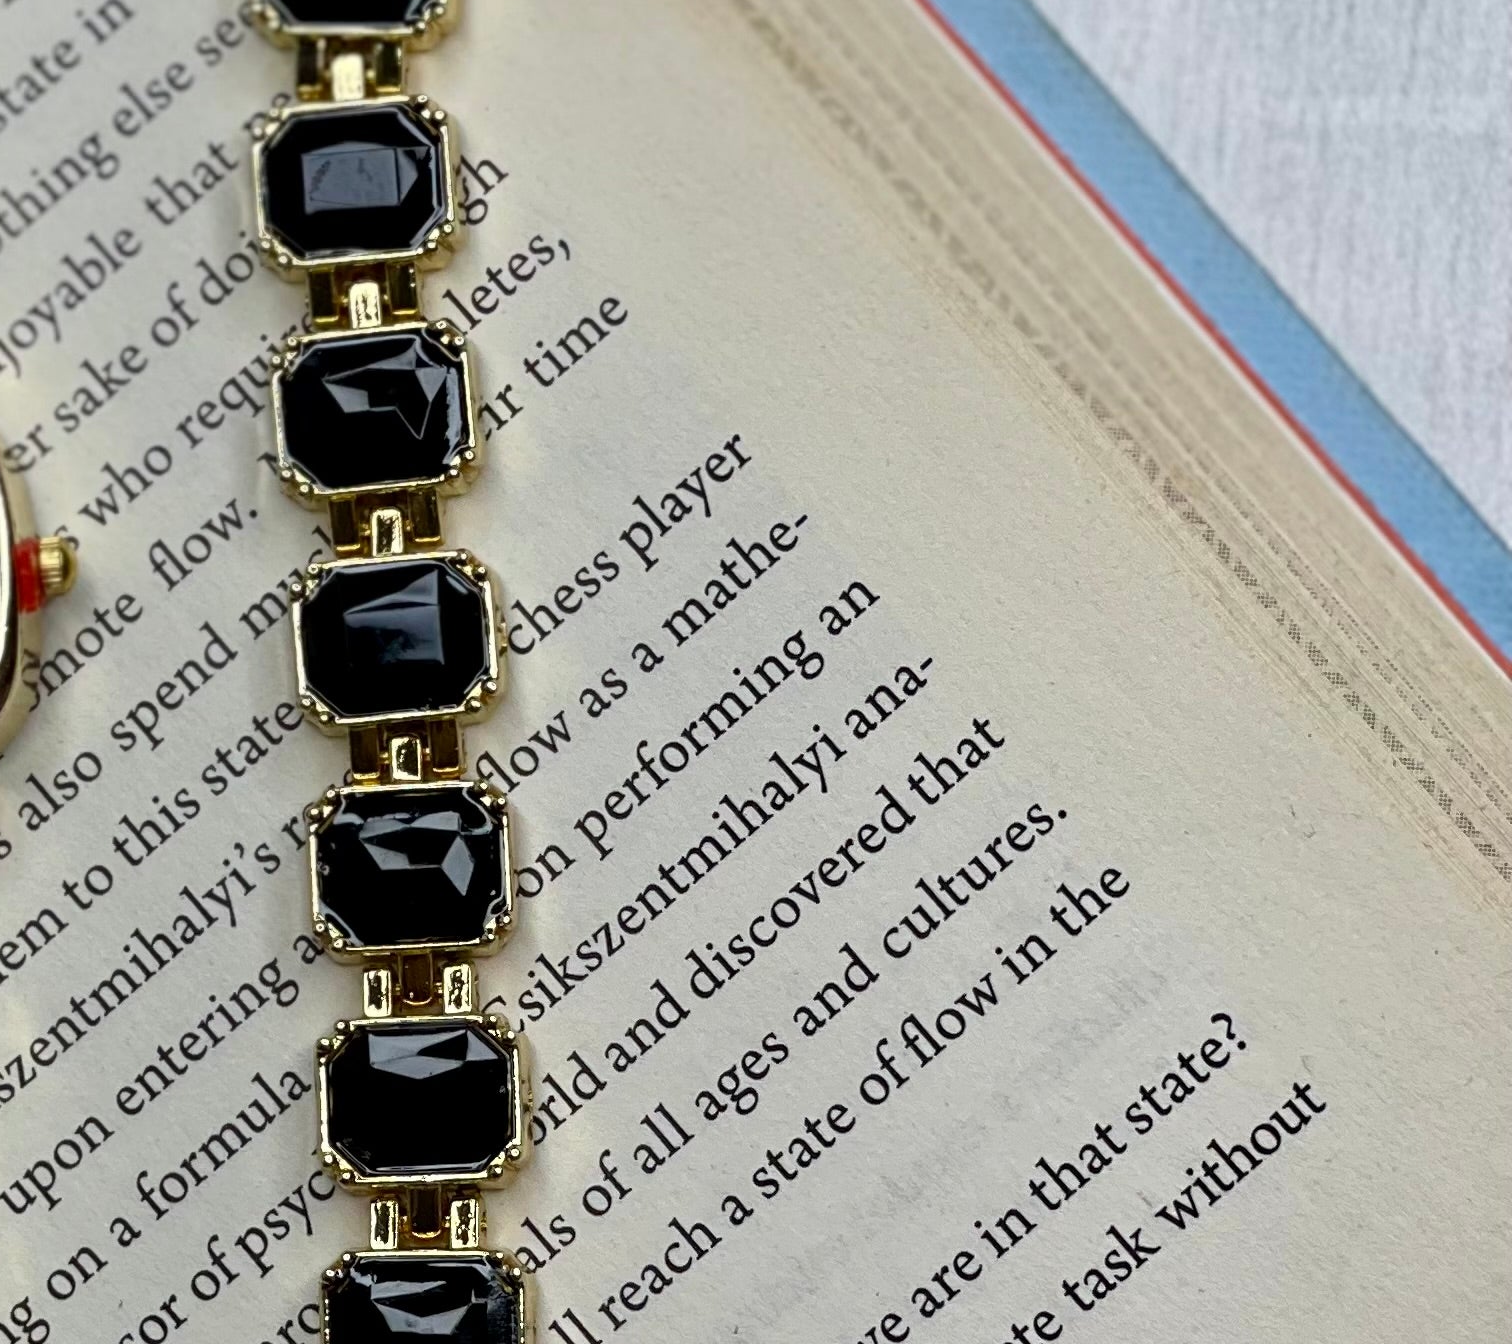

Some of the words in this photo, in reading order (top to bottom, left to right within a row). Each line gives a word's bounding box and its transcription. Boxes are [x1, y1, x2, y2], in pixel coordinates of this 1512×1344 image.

[18, 751, 103, 831] also
[111, 621, 238, 752] spend
[523, 297, 628, 387] time
[505, 550, 620, 655] chess
[619, 434, 752, 571] player
[47, 1246, 108, 1300] on
[110, 1216, 142, 1247] a
[136, 1070, 312, 1220] formula
[510, 844, 576, 899] on
[574, 629, 825, 860] performing
[819, 581, 880, 635] an
[62, 864, 114, 910] to
[112, 788, 201, 866] this
[201, 697, 312, 795] state
[116, 957, 300, 1116] entering
[579, 668, 628, 718] as
[632, 642, 665, 673] a
[662, 514, 808, 646] mathe-
[191, 1234, 240, 1301] of
[845, 657, 933, 739] ana-
[582, 1149, 632, 1216] of
[633, 1102, 695, 1174] all
[695, 1031, 789, 1121] ages
[793, 943, 880, 1036] and
[883, 803, 1067, 959] cultures.
[605, 980, 691, 1072] and
[686, 785, 916, 999] discovered
[907, 718, 1005, 805] that
[598, 1218, 723, 1331] reach
[721, 1195, 755, 1226] a
[752, 1103, 856, 1199] state
[860, 1039, 910, 1105] of
[901, 972, 999, 1067] flow
[995, 934, 1057, 984] in
[1050, 868, 1130, 936] the
[911, 1251, 983, 1318] are
[975, 1208, 1037, 1258] in
[1029, 1123, 1128, 1210] that
[1125, 1012, 1247, 1135] state?
[1062, 1226, 1162, 1311] task
[1155, 1082, 1327, 1229] without
